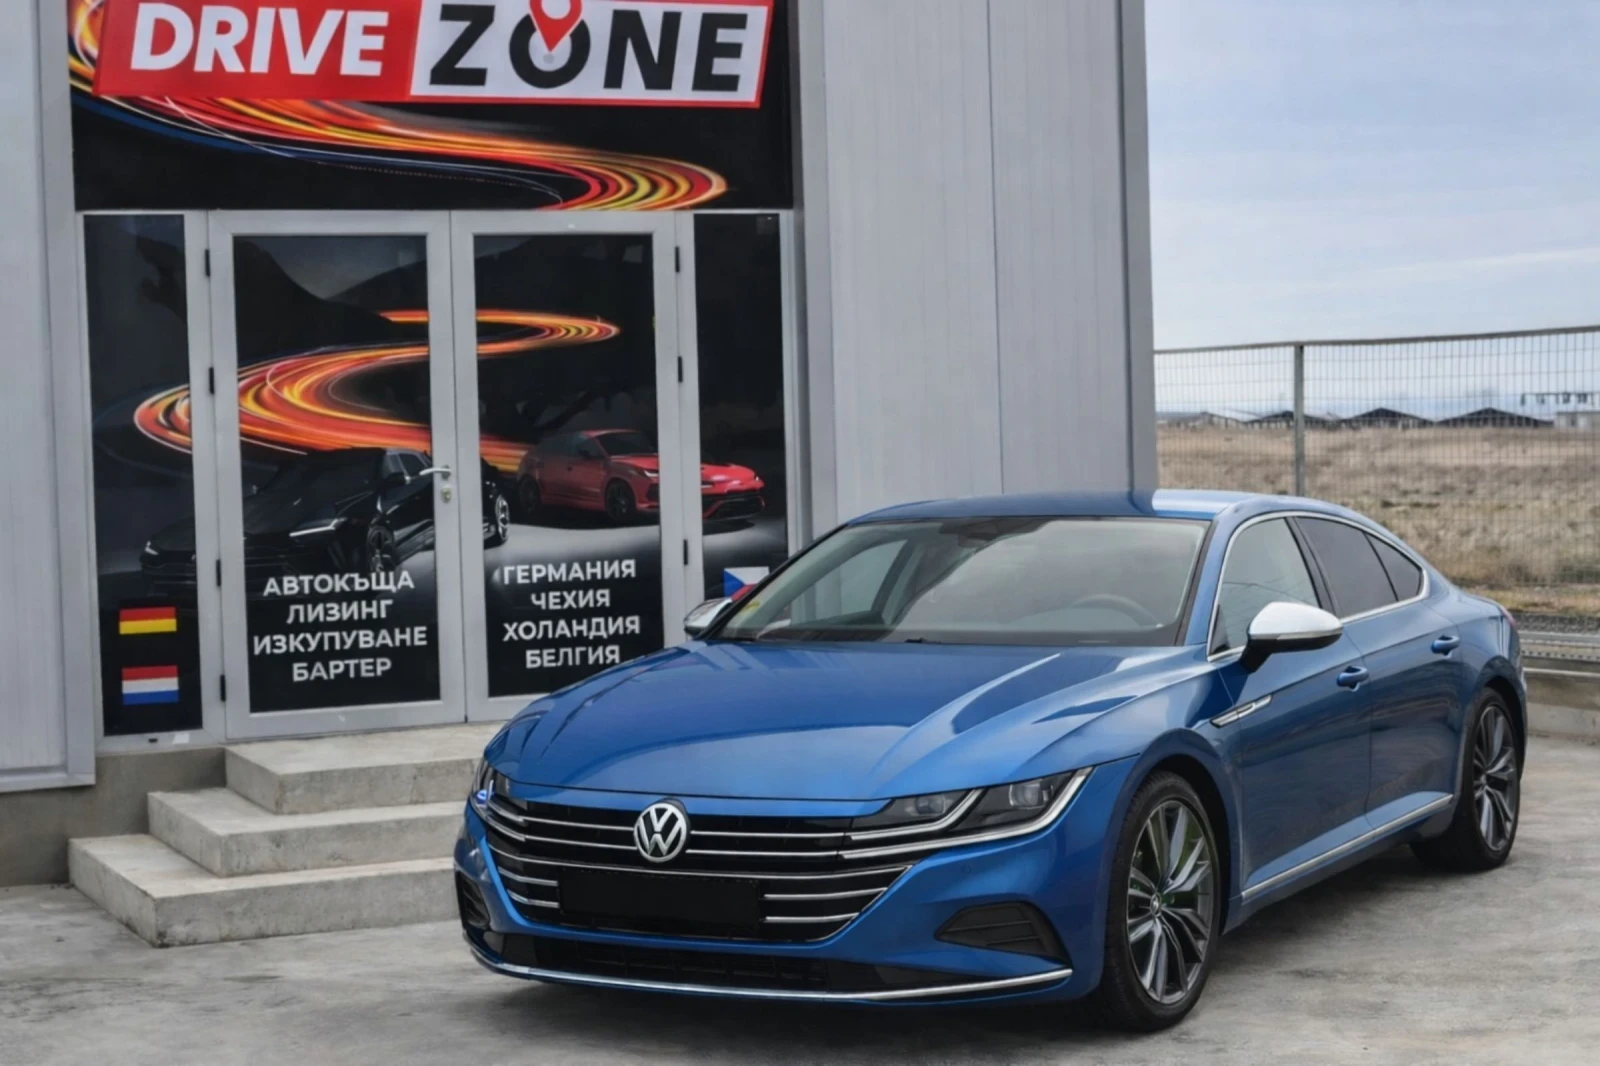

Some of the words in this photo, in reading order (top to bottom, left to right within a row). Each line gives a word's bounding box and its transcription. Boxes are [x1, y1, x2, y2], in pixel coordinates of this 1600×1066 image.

[131, 2, 389, 77] DRIVE
[429, 3, 748, 92] ZONE
[263, 570, 414, 597] АВТОКЪЩА
[503, 558, 636, 585] ГЕРМАНИЯ
[286, 599, 393, 624] ЛИЗИНГ
[530, 588, 610, 610] ЧЕХИЯ
[253, 626, 427, 655] ИЗКУПУВАНЕ
[503, 615, 641, 642] ХОЛАНДИЯ
[292, 657, 392, 682] БАРТЕР
[525, 645, 620, 669] БЕЛГИЯ
[635, 804, 685, 861] VW
